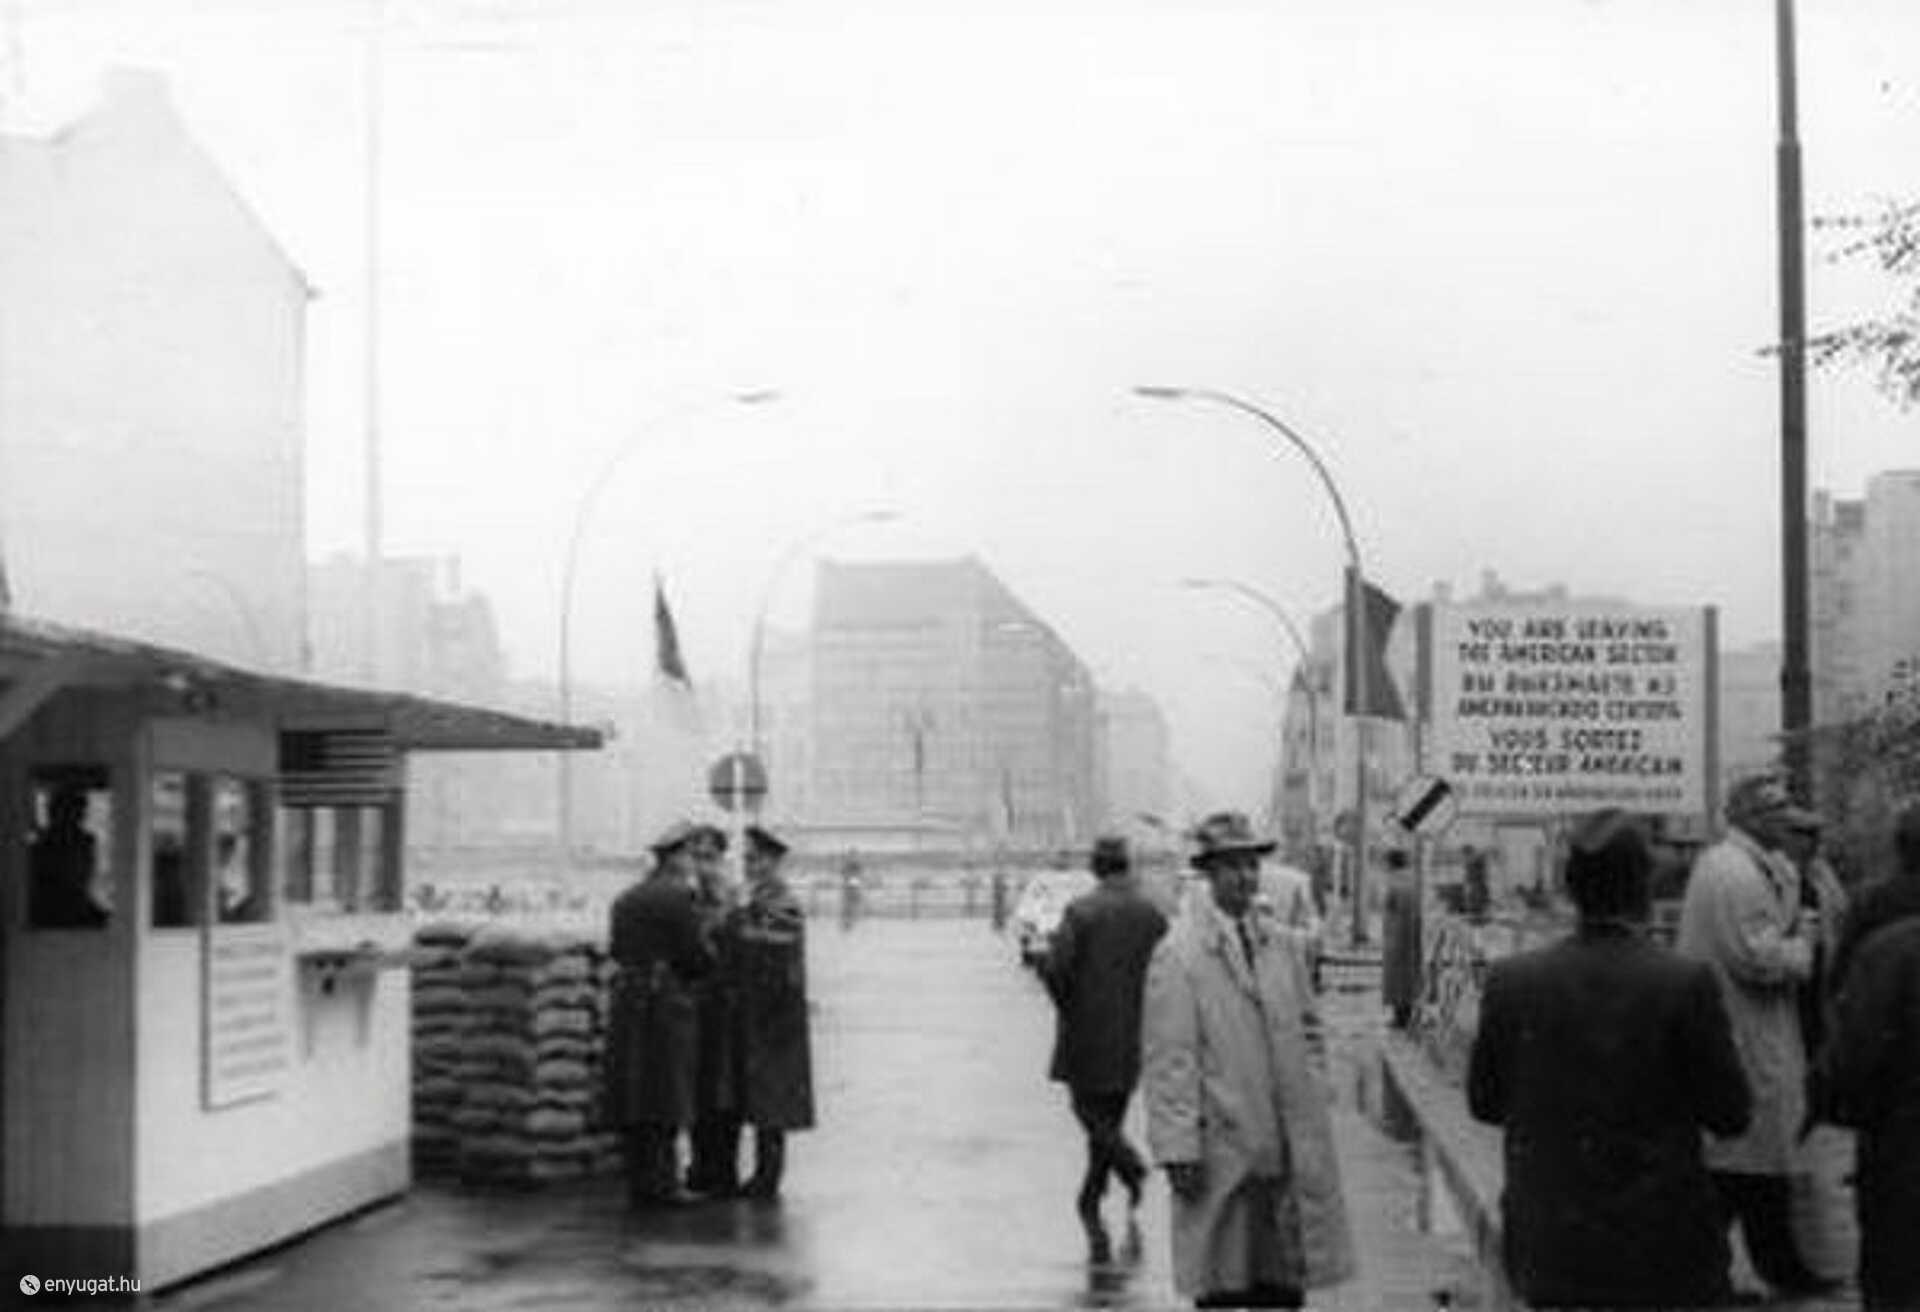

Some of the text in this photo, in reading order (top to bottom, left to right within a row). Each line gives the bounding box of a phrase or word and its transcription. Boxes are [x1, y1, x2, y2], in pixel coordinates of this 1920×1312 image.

[1468, 619, 1669, 639] YOU ARE LEAVING
[1500, 642, 1595, 664] AMERICAN
